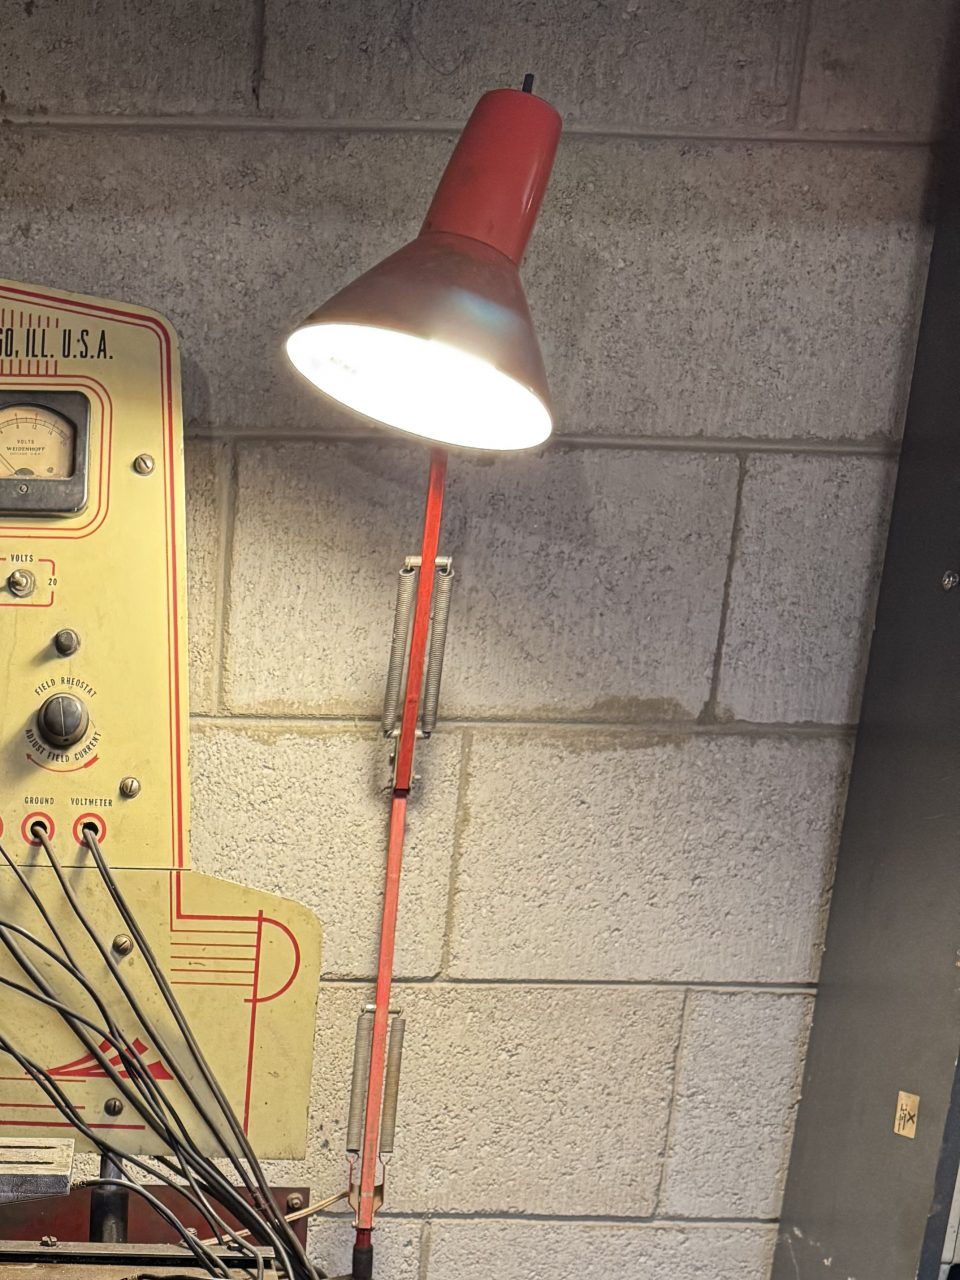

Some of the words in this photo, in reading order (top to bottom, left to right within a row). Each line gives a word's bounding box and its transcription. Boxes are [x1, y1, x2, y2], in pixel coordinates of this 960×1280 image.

[25, 328, 54, 358] ILL.
[62, 329, 113, 359] U.S.A.
[10, 554, 34, 563] VOLTS
[48, 578, 58, 586] 20
[34, 678, 56, 696] FIELD
[61, 676, 97, 698] RHEOSTAT
[25, 729, 47, 755] ADJUST
[46, 751, 70, 763] FIELD
[74, 731, 102, 761] CURRENT
[24, 796, 55, 805] GROUND
[71, 797, 113, 806] VOLTMETER
